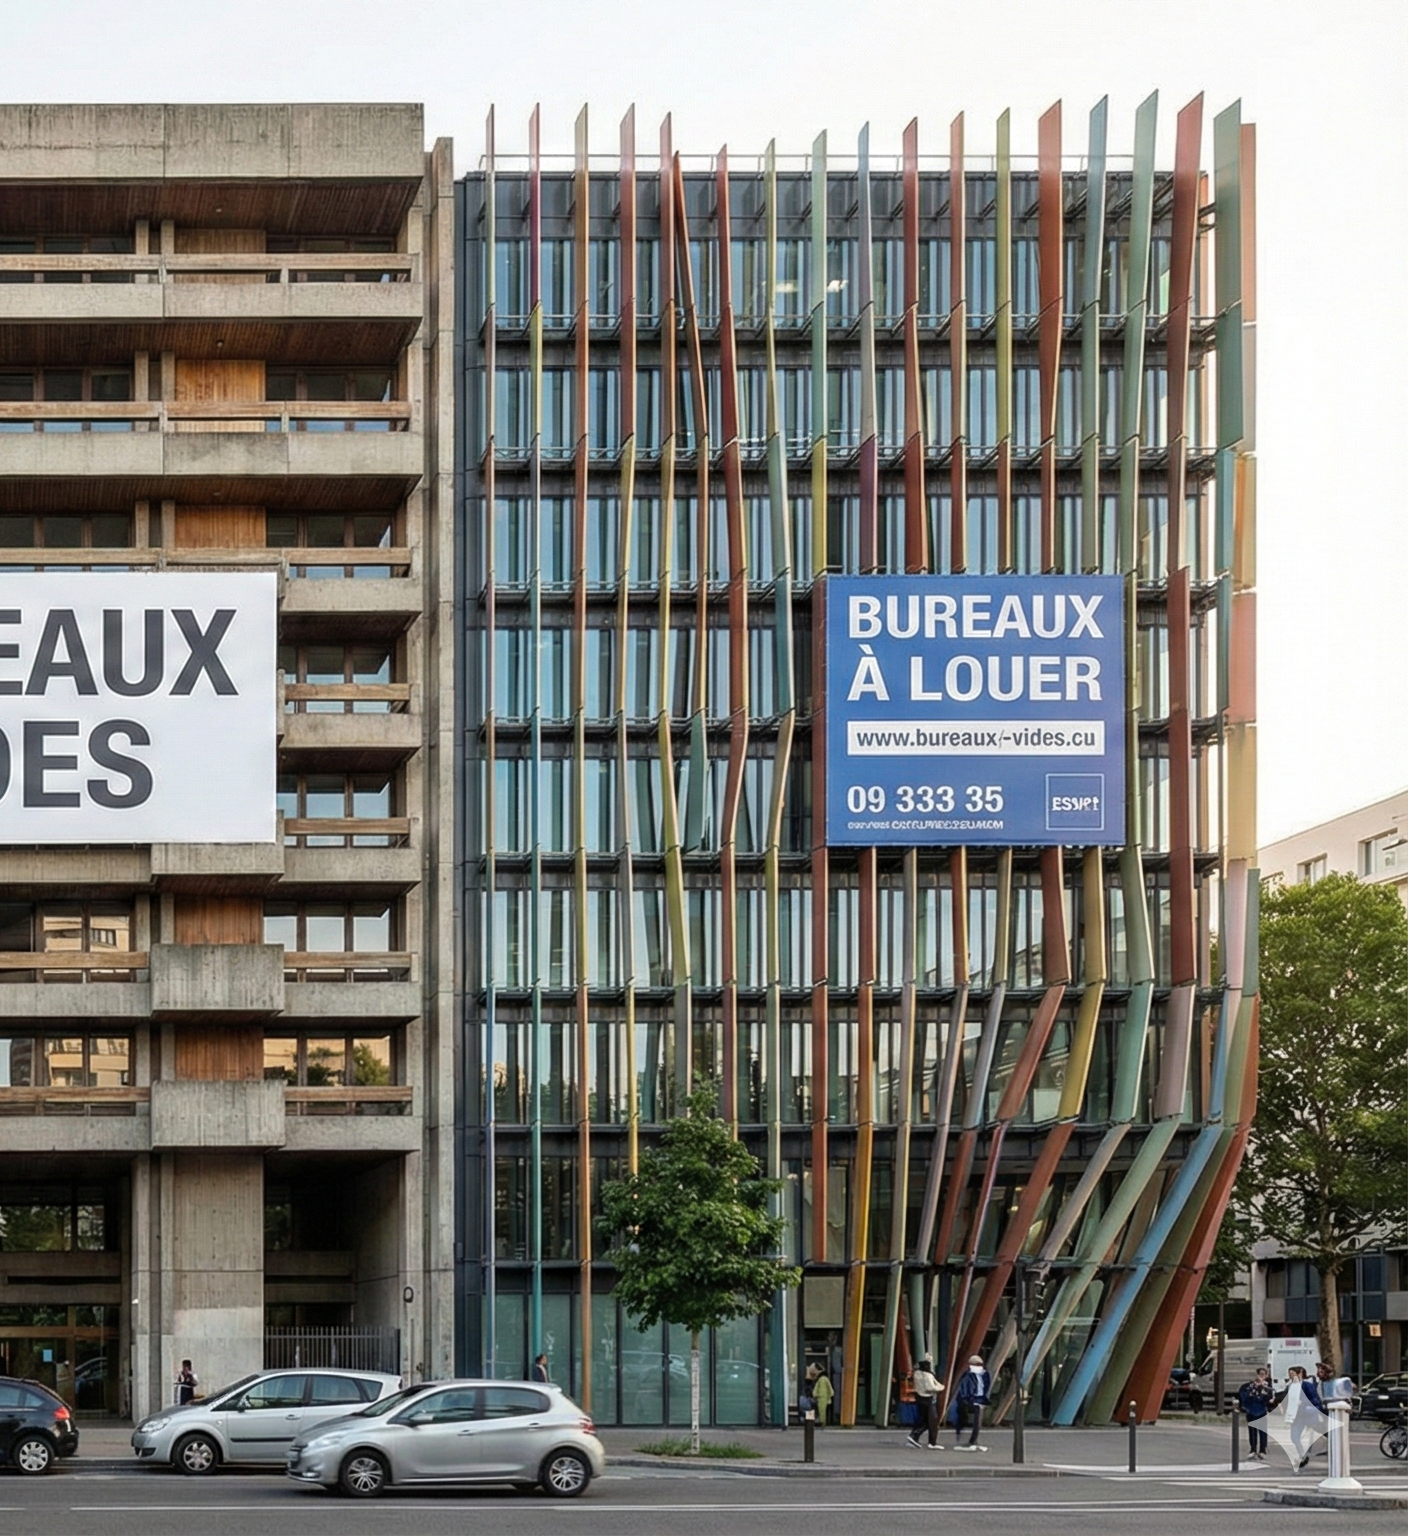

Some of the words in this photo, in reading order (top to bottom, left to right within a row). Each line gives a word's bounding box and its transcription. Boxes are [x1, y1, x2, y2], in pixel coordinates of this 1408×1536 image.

[849, 594, 1104, 639] BUREAUX
[847, 644, 890, 701] À
[910, 655, 1102, 702] LOUER
[847, 785, 886, 813] 09
[895, 785, 955, 813] 333
[965, 785, 1004, 813] 35
